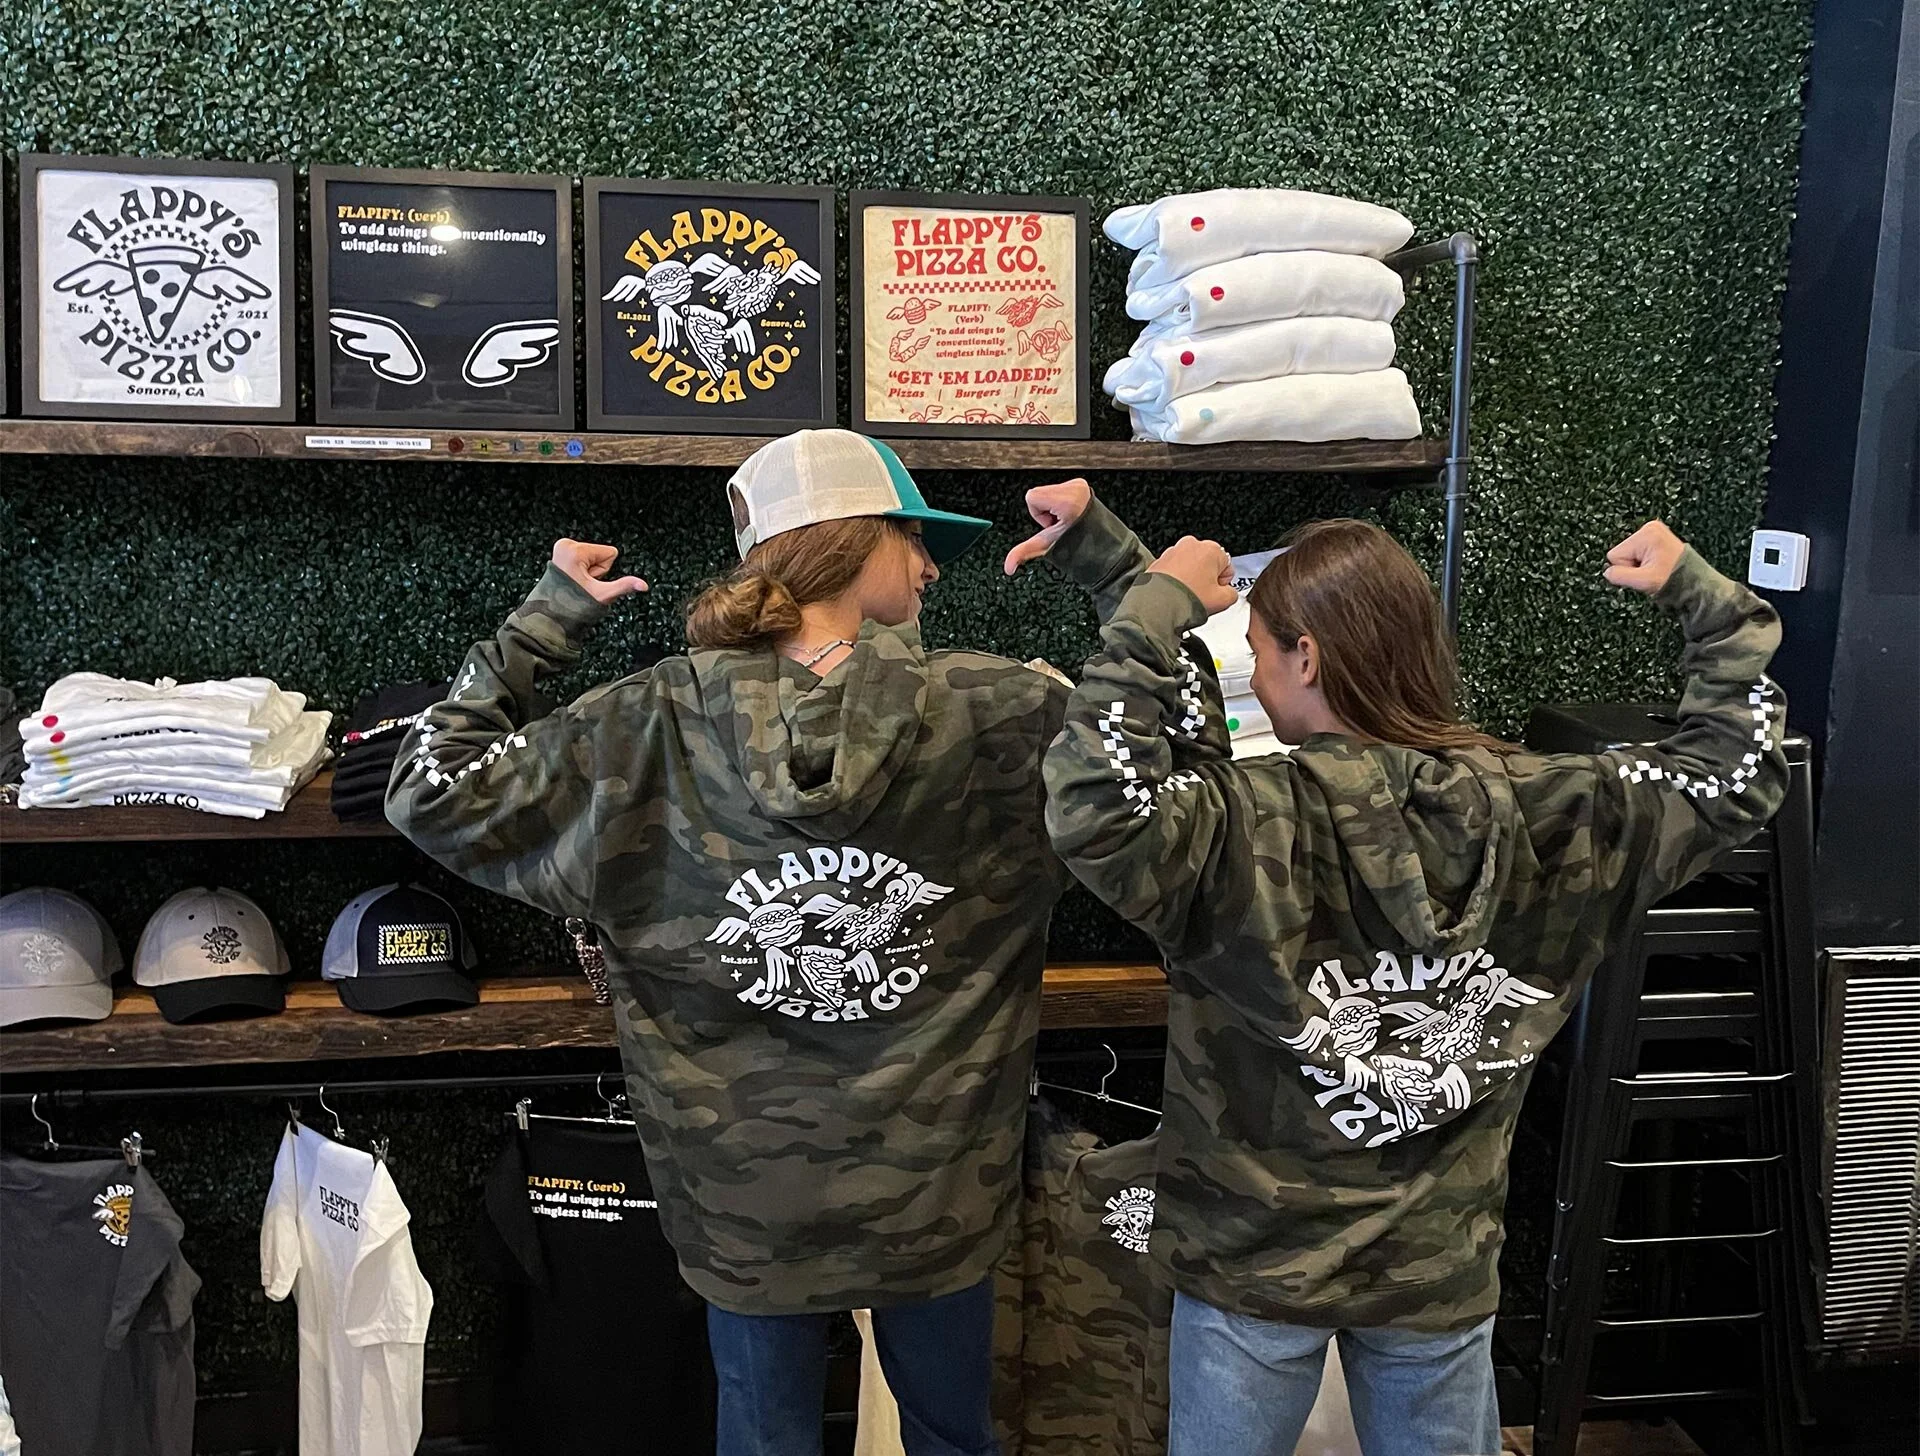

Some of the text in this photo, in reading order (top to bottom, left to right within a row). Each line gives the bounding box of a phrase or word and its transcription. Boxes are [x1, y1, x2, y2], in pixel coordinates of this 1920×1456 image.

[67, 186, 262, 258] FLAPPY'S
[337, 206, 450, 223] FLAPIFY: (verb)
[339, 222, 546, 245] To add wings nventionally
[892, 214, 1043, 246] FLAPPY'S
[341, 239, 447, 256] wingless things.
[624, 208, 798, 274] FLAPPY'S
[895, 246, 1046, 276] PIZZA CO.
[67, 303, 93, 314] Est.
[237, 310, 268, 319] 2021
[948, 304, 991, 313] FLAPIFY:
[761, 319, 806, 329] Sonora, CA
[955, 315, 984, 324] (Verb)
[968, 327, 993, 336] wings
[936, 337, 1005, 347] conventionally
[79, 319, 261, 385] PIZZA CO.
[936, 349, 974, 358] wingless
[630, 335, 800, 403] PIZZA CO.
[888, 370, 933, 385] “GET
[974, 368, 1062, 385] LOADED!”
[127, 384, 205, 398] Sonora, CA
[888, 385, 1058, 400] Pizzas Burgers Fries
[114, 792, 167, 807] PIZZA
[725, 846, 925, 912] FLAPPY'S
[385, 929, 446, 944] FLAPPY'S
[386, 943, 427, 957] PIZZA
[884, 937, 935, 955] Sonora, CA
[737, 964, 929, 1022] PIZZA CO.
[528, 1176, 625, 1193] FLAPIFY: (verb)
[528, 1190, 543, 1200] To
[545, 1192, 567, 1203] add
[570, 1194, 605, 1207] wings
[608, 1197, 620, 1206] to
[531, 1204, 623, 1222] wingless things.
